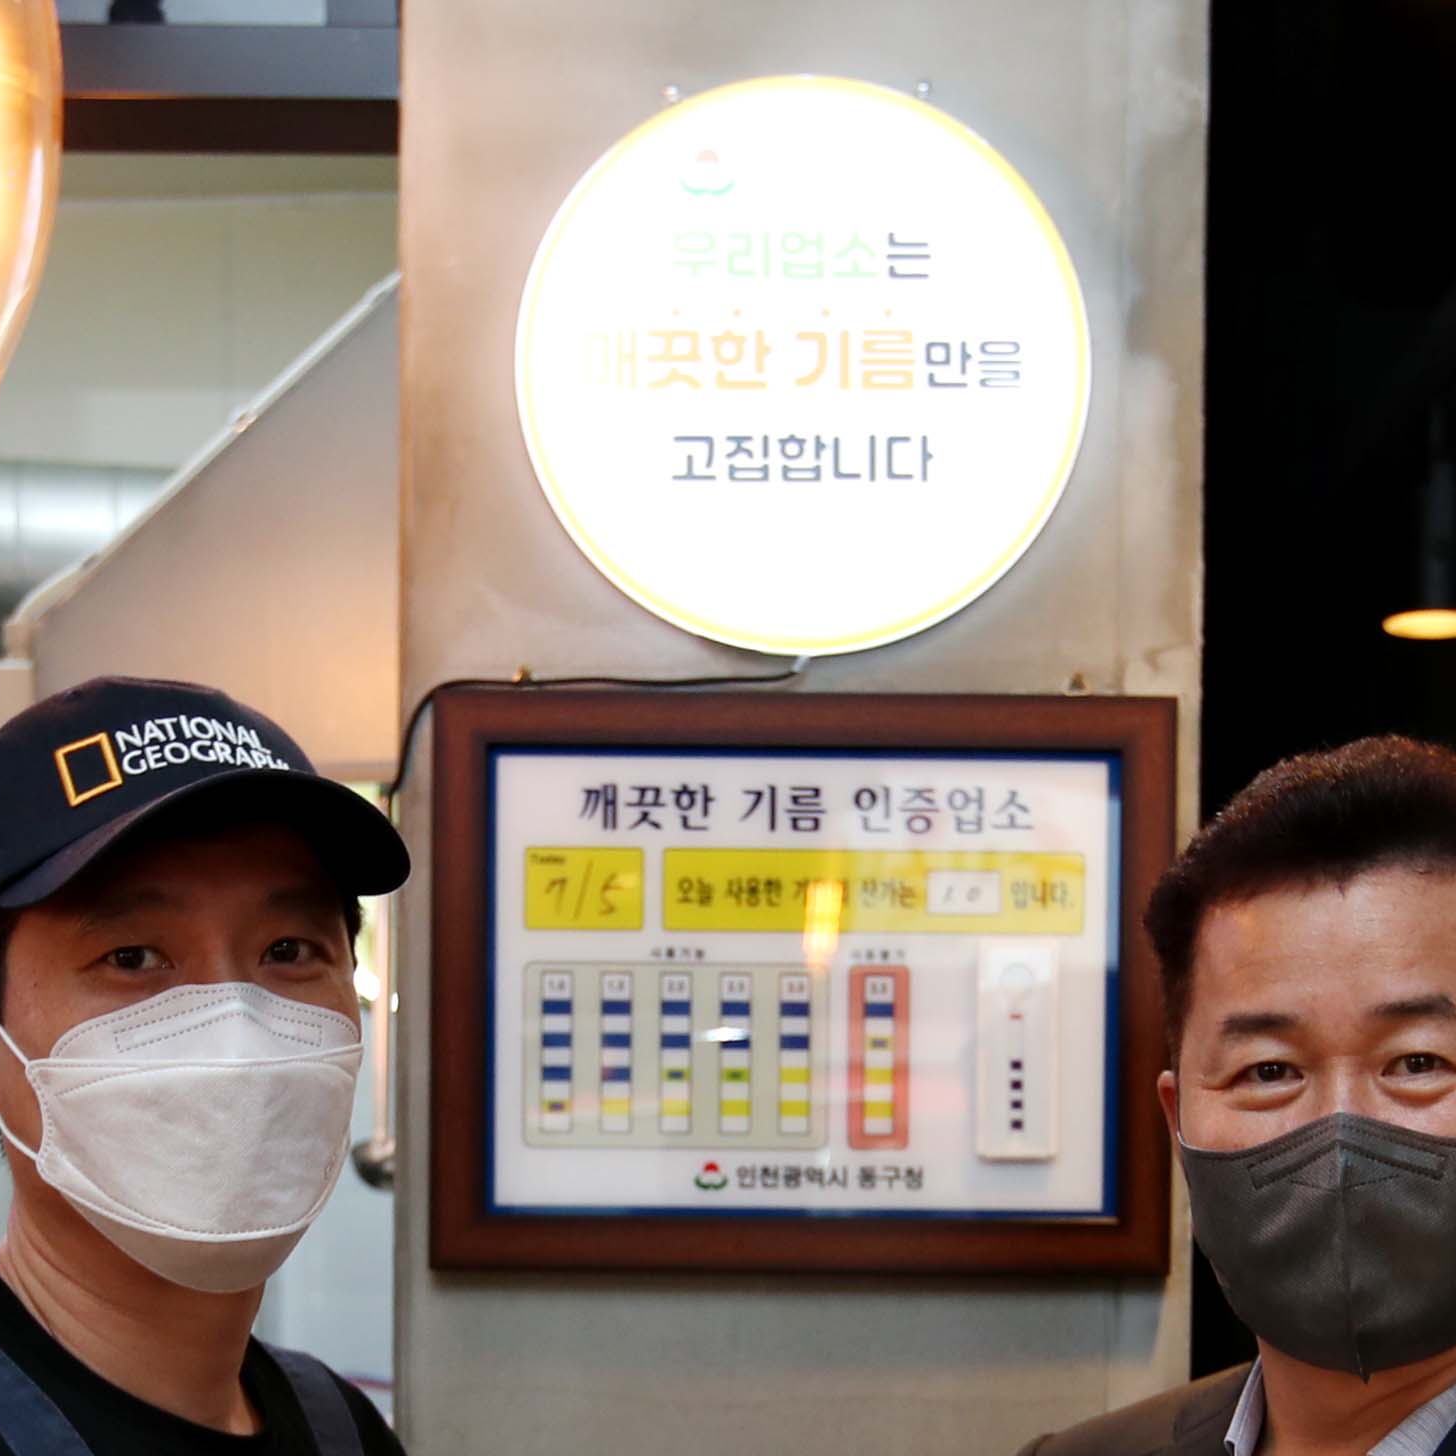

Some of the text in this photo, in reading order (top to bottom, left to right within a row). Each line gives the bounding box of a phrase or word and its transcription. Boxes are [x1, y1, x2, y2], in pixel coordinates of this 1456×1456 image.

[671, 231, 932, 279] 우리업소는
[585, 329, 1022, 390] 깨끗한 기름만을
[671, 434, 934, 482] 고집합니다
[115, 714, 272, 753] NATIONAL
[579, 783, 1035, 835] 깨끗한 기름 인증업소
[677, 876, 714, 908] 오늘
[725, 876, 783, 908] 사용한
[736, 1165, 924, 1190] 인천광역시 동구청
